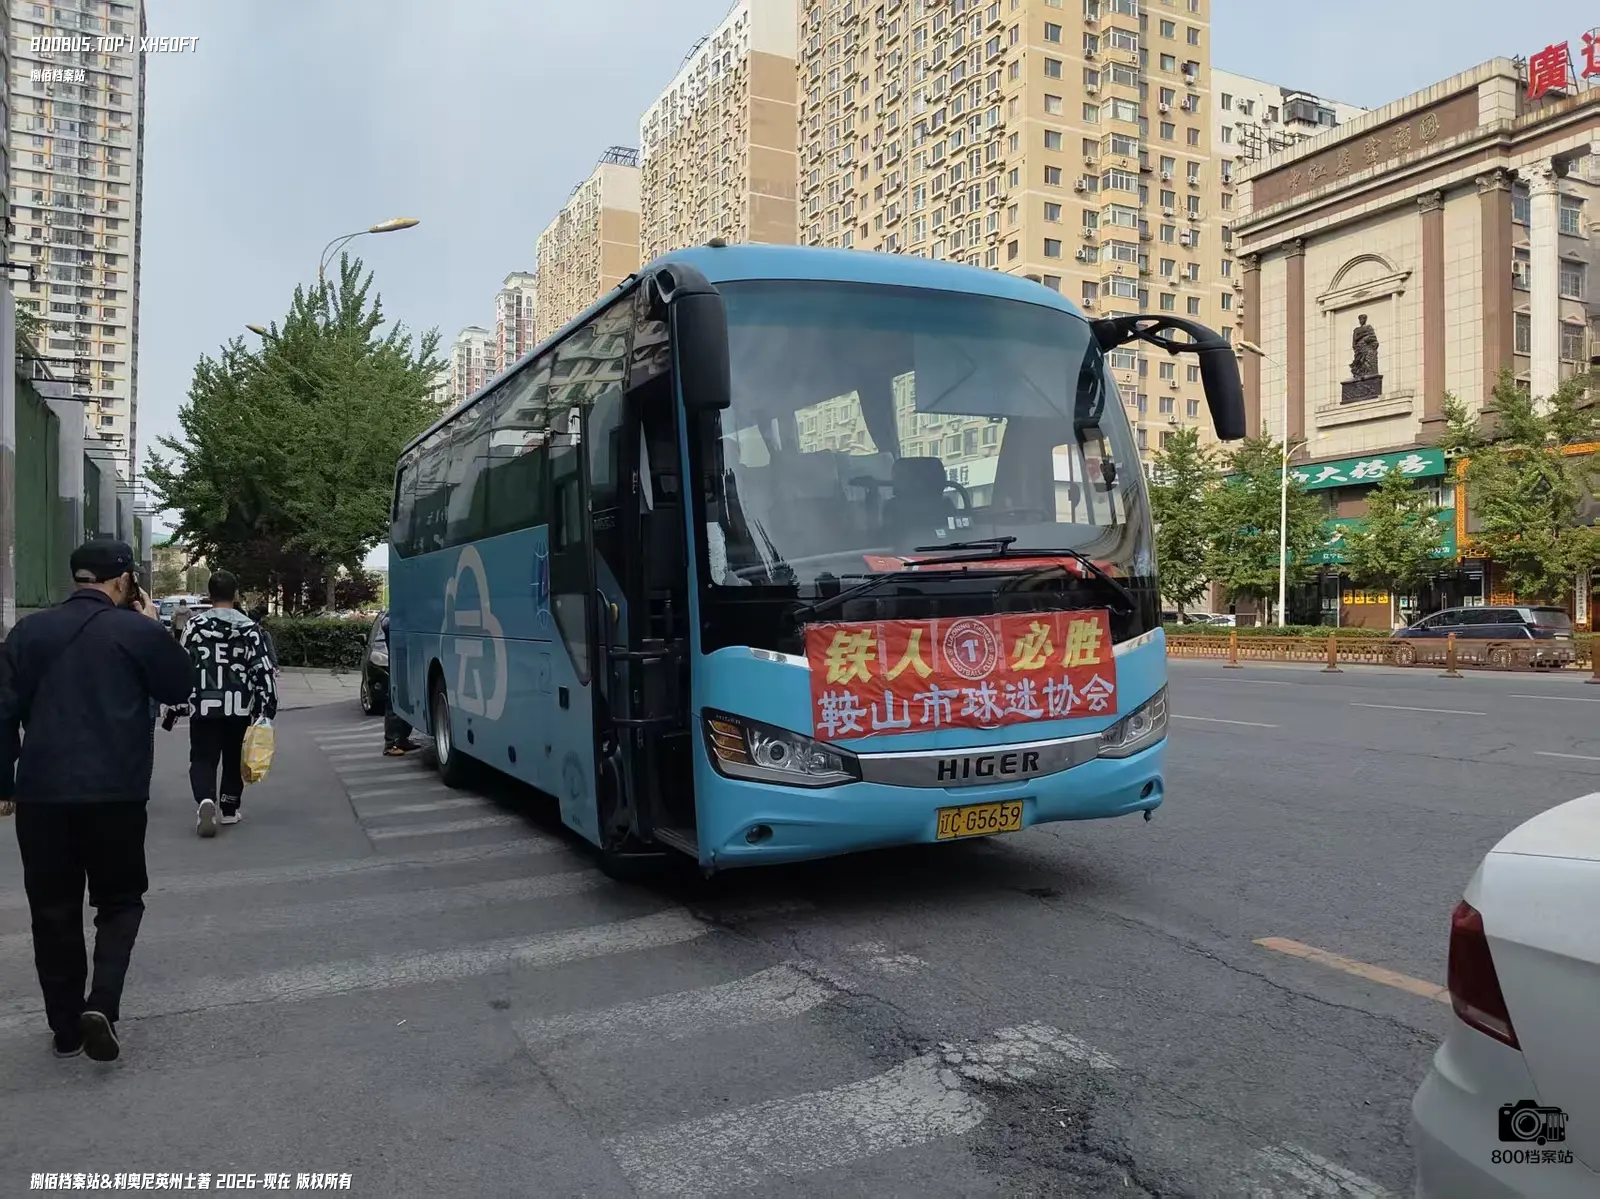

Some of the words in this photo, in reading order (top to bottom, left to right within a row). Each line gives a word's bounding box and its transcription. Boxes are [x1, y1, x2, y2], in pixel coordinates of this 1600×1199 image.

[1525, 31, 1600, 99] 廣
[824, 628, 934, 685] 铁人
[1010, 616, 1104, 672] 必胜
[817, 673, 1115, 737] 鞍山市球迷协会
[938, 752, 1040, 781] HIGER
